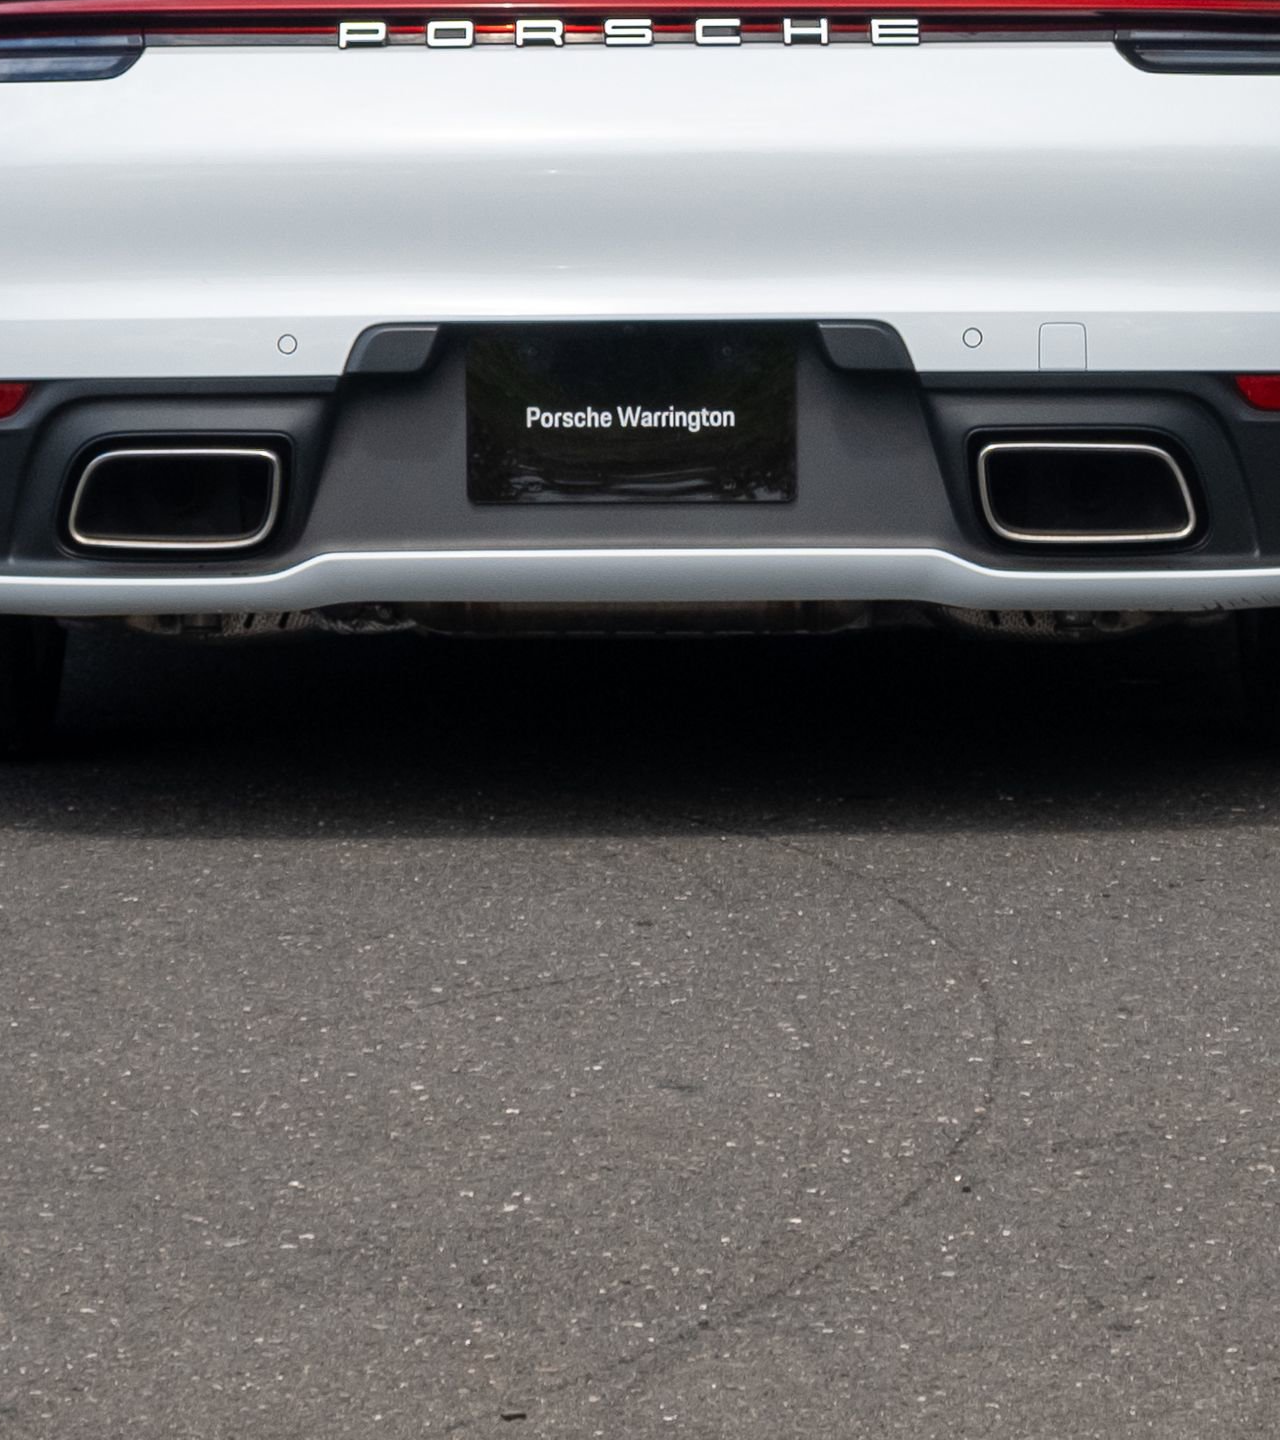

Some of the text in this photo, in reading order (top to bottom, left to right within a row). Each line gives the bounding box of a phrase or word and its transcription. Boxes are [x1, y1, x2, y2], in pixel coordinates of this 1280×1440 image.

[338, 18, 921, 48] PORSCHE
[525, 405, 736, 433] Porsche Warrington
